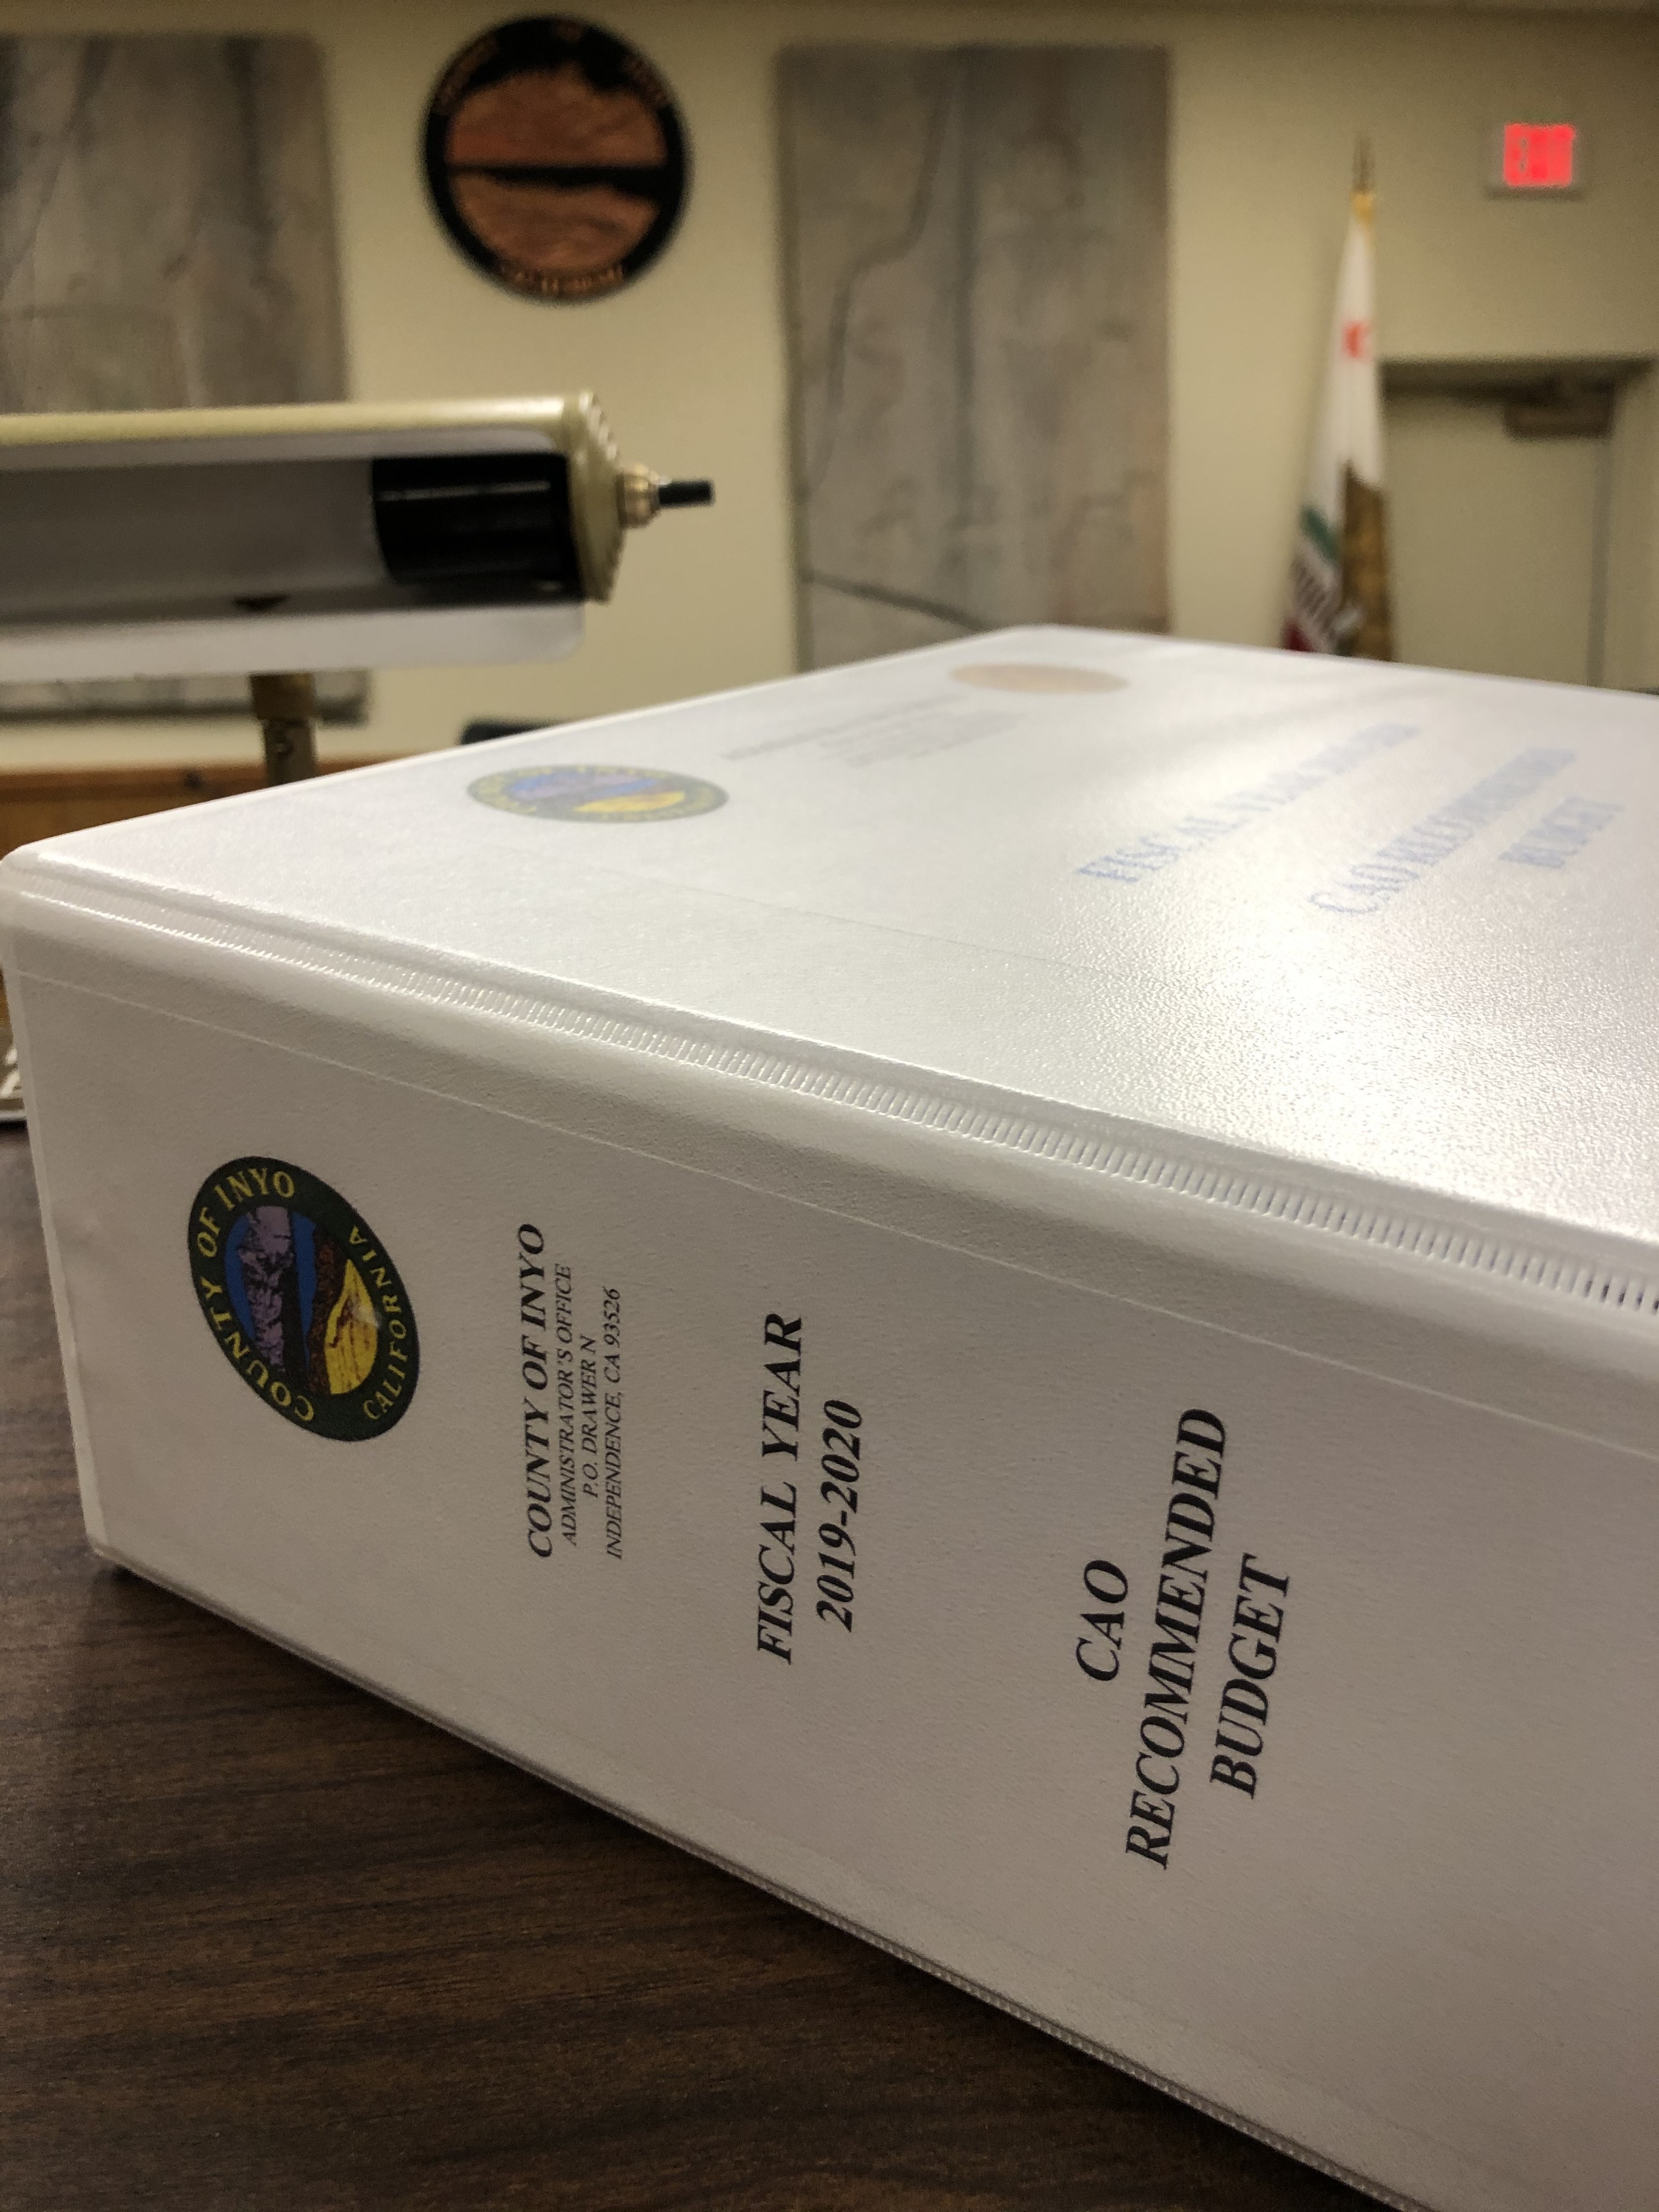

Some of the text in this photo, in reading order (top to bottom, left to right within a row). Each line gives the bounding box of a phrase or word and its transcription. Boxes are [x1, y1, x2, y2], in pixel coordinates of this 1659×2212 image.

[198, 1168, 315, 1421] COUNTY OF INYO
[349, 1225, 408, 1420] CALIFORNIA
[517, 1223, 552, 1558] COUNTY OF INYO
[555, 1263, 577, 1547] ADMINISTRATOR'S OFFICE
[580, 1334, 599, 1499] P.O. DRAWER N
[603, 1286, 624, 1560] INDEPENDENCE, CA 93526
[757, 1313, 802, 1665] FISCAL YEAR
[816, 1399, 863, 1633] 2019-2020
[1075, 1559, 1129, 1683] CAO
[1125, 1408, 1227, 1870] RECOMMENDED
[1210, 1552, 1290, 1800] BUDGET
